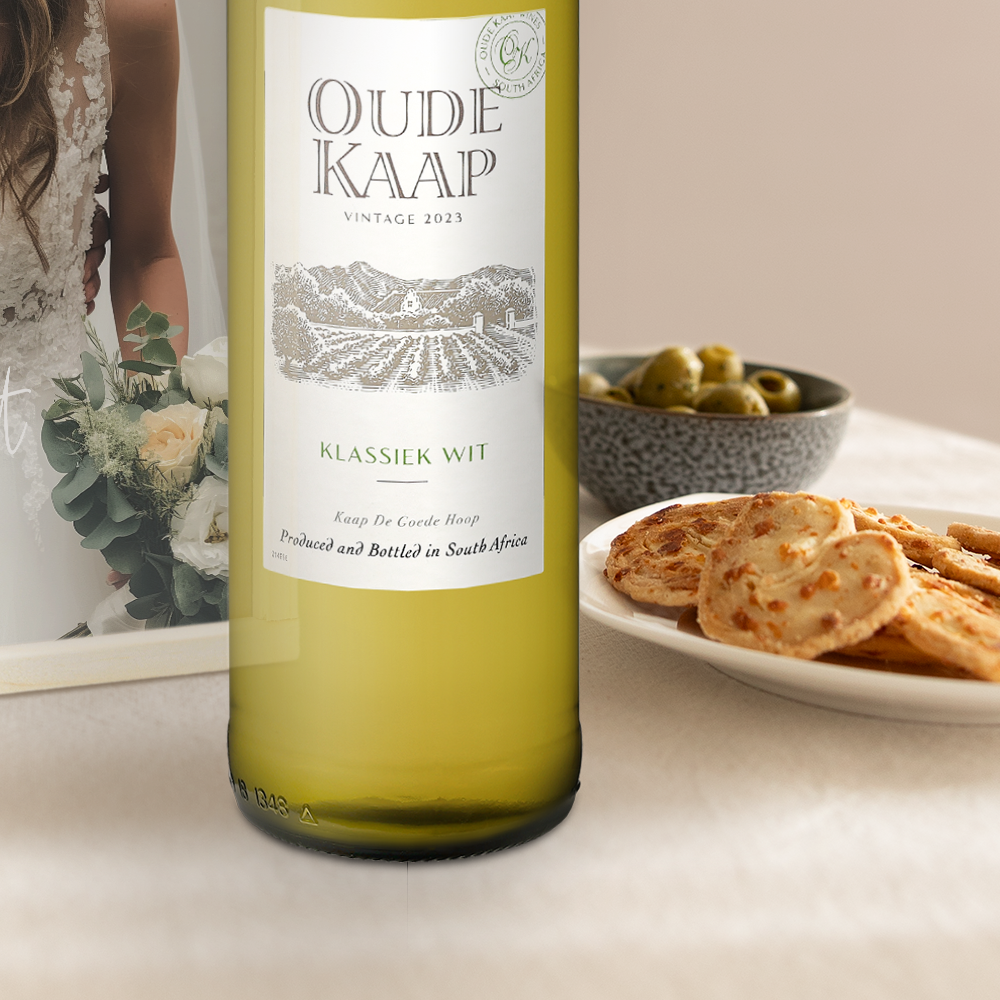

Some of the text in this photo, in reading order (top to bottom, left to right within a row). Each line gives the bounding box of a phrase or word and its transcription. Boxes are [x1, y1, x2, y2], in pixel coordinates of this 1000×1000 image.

[480, 26, 495, 60] OUDE
[493, 79, 525, 93] SOUTH
[307, 77, 503, 137] OUDE
[313, 138, 497, 200] KAAP
[343, 211, 463, 225] VINTAGE 2023
[320, 441, 489, 466] KLASSIEK WIT
[333, 510, 480, 529] Kaap De Goede Hoop
[280, 528, 528, 559] Produced and Bottled in South Africa
